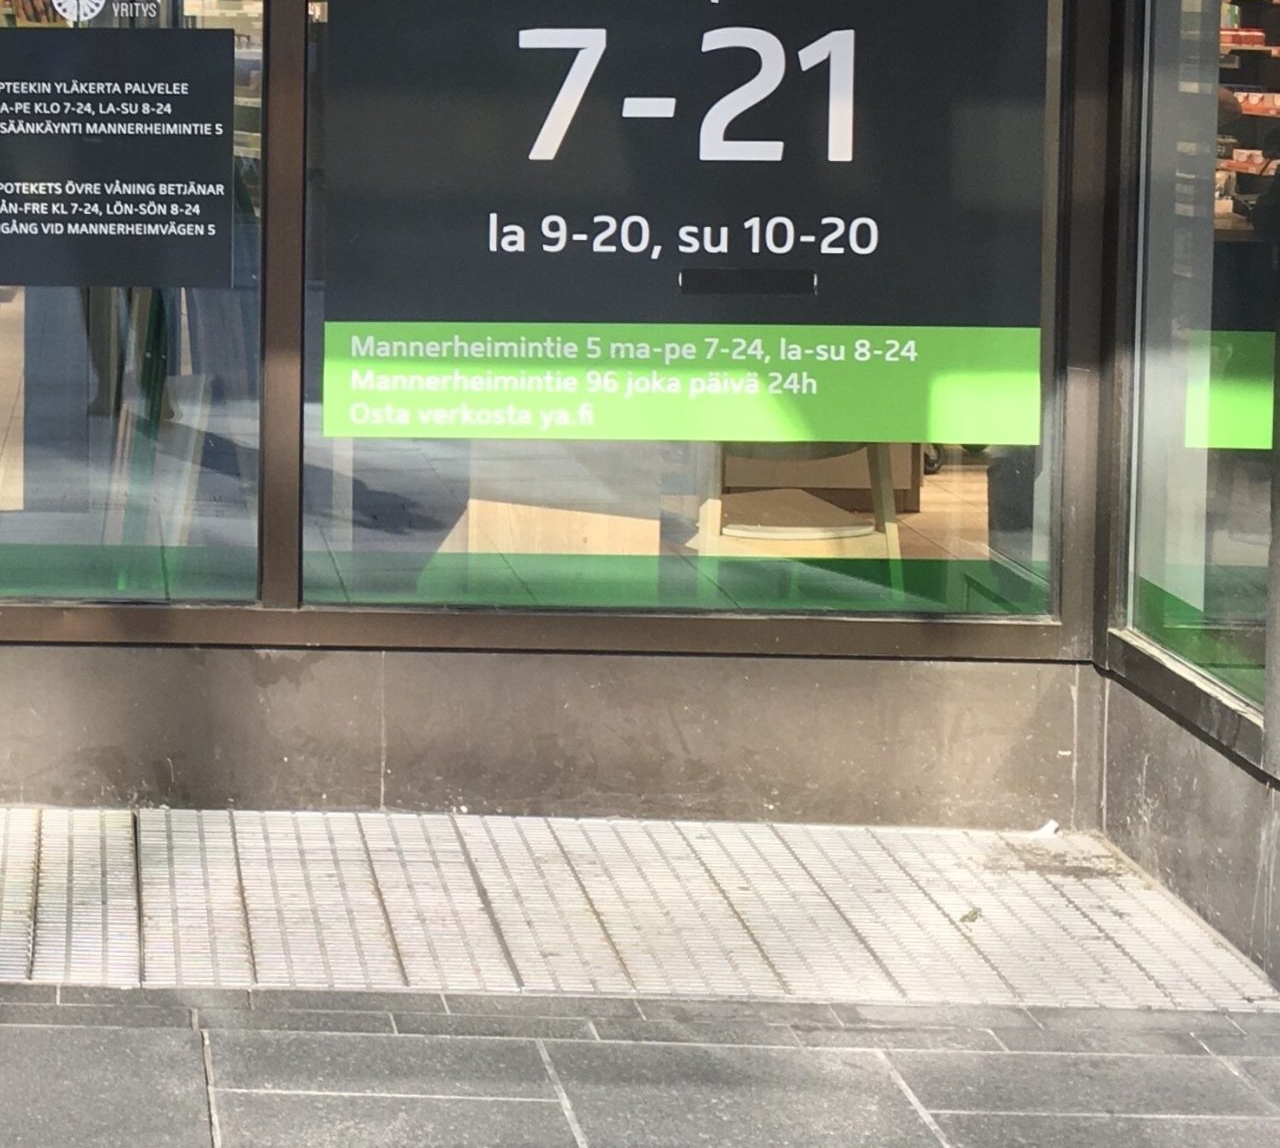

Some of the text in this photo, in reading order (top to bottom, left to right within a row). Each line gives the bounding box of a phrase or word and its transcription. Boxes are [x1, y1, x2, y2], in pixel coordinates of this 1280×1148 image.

[112, 3, 157, 18] YRITYS
[54, 79, 122, 94] YLÄKERTA
[124, 82, 189, 95] PALVELEE
[518, 26, 856, 162] 7-21
[34, 101, 61, 114] KLO
[63, 101, 96, 116] 7-24,
[98, 102, 139, 115] LA-SU
[141, 102, 173, 115] 8-24
[85, 122, 212, 135] MANNERHEIMINTIE
[214, 123, 224, 136] 5
[64, 179, 102, 195] ÖVRE
[103, 179, 156, 196] VÅNING
[158, 180, 225, 196] BETJÄNAR
[51, 202, 69, 215] KL
[70, 202, 103, 217] 7-24,
[106, 200, 167, 216] LÖN-SÖN
[169, 203, 201, 216] 8-24
[40, 222, 65, 235] VID
[66, 220, 205, 236] MANNERHEIMVÄGEN
[207, 223, 216, 236] 5
[488, 212, 879, 260] la 9-20, su 10-20
[350, 335, 919, 365] Mannerheimintie 5 ma-pe 7-24, la-su 8-24
[350, 368, 818, 400] Mannerheimintie 96 joka päivä 24h
[349, 402, 596, 433] Osta verkosta ya.fi
